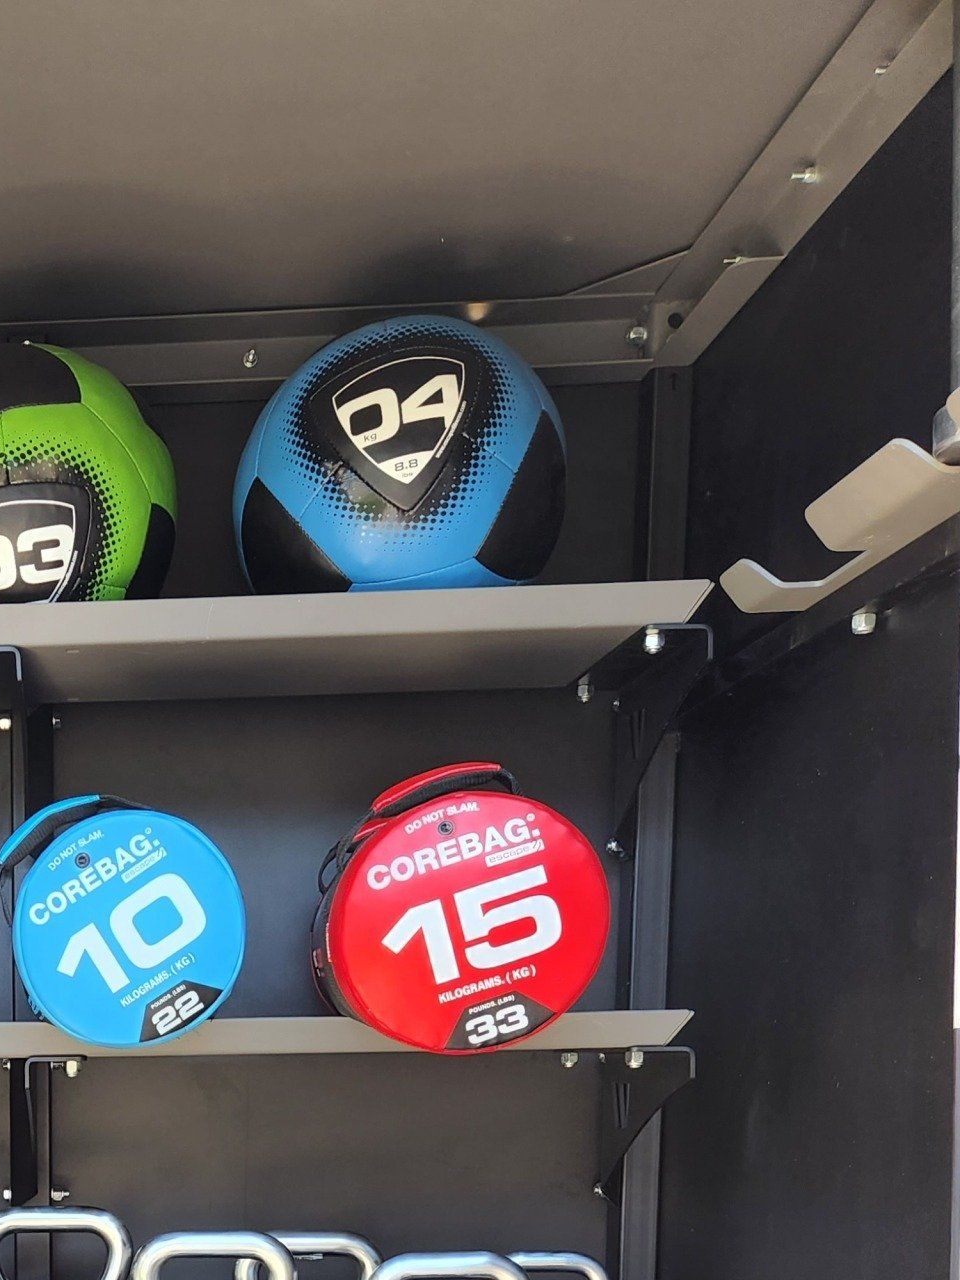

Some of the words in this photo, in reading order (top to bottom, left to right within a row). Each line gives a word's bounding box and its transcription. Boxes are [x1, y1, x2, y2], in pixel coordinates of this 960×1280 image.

[337, 374, 460, 449] 04
[364, 432, 377, 443] kg
[394, 458, 419, 473] 8.8
[404, 820, 422, 835] DO
[422, 808, 446, 827] NOT
[48, 858, 62, 872] DO
[60, 843, 79, 860] NOT
[487, 842, 536, 866] escape
[56, 872, 207, 994] 10
[380, 865, 563, 985] 15
[151, 990, 205, 1036] 22
[465, 1004, 529, 1044] 33
